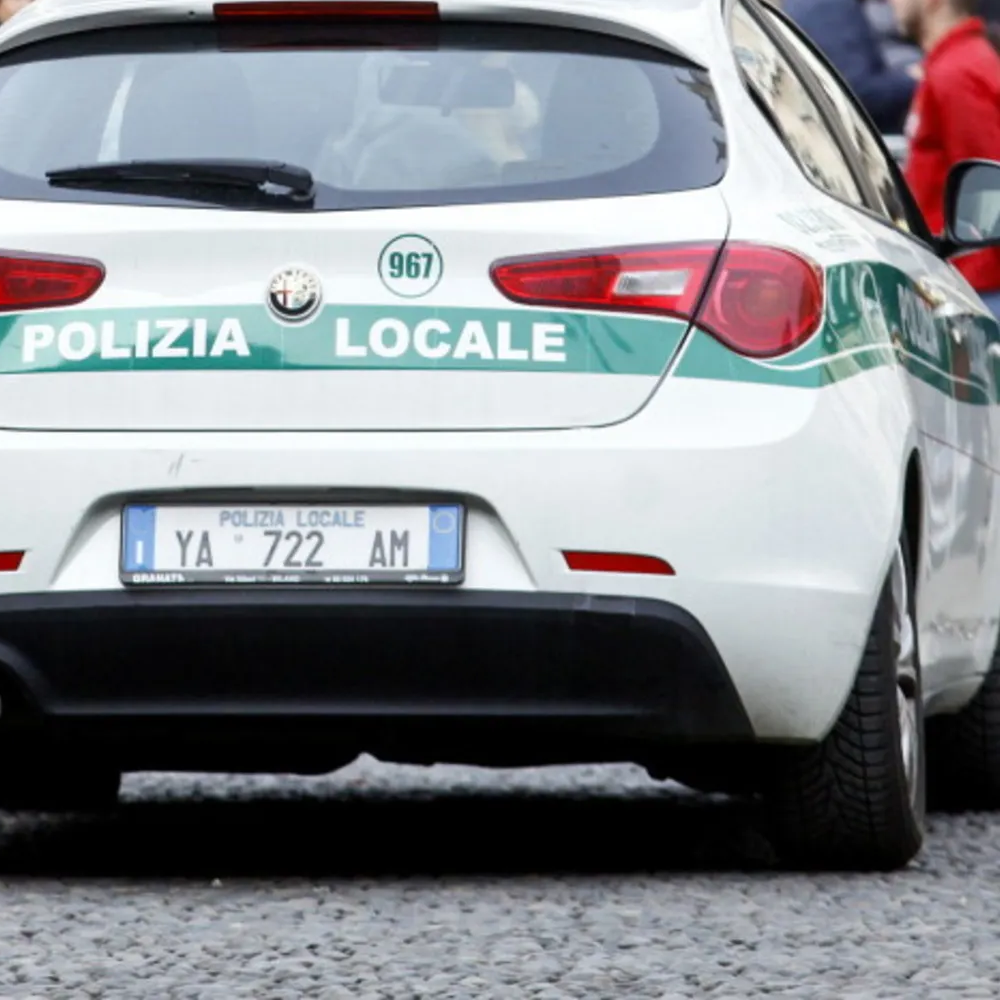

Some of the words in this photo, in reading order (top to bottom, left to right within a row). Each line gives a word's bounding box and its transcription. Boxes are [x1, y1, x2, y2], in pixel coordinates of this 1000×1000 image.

[389, 251, 434, 280] 967
[22, 318, 251, 363] POLIZIA
[335, 317, 567, 362] LOCALE
[219, 510, 285, 527] POLIZIA
[296, 510, 365, 527] LOCALE
[175, 530, 214, 568] YA
[263, 531, 325, 567] 722
[369, 531, 410, 567] AM
